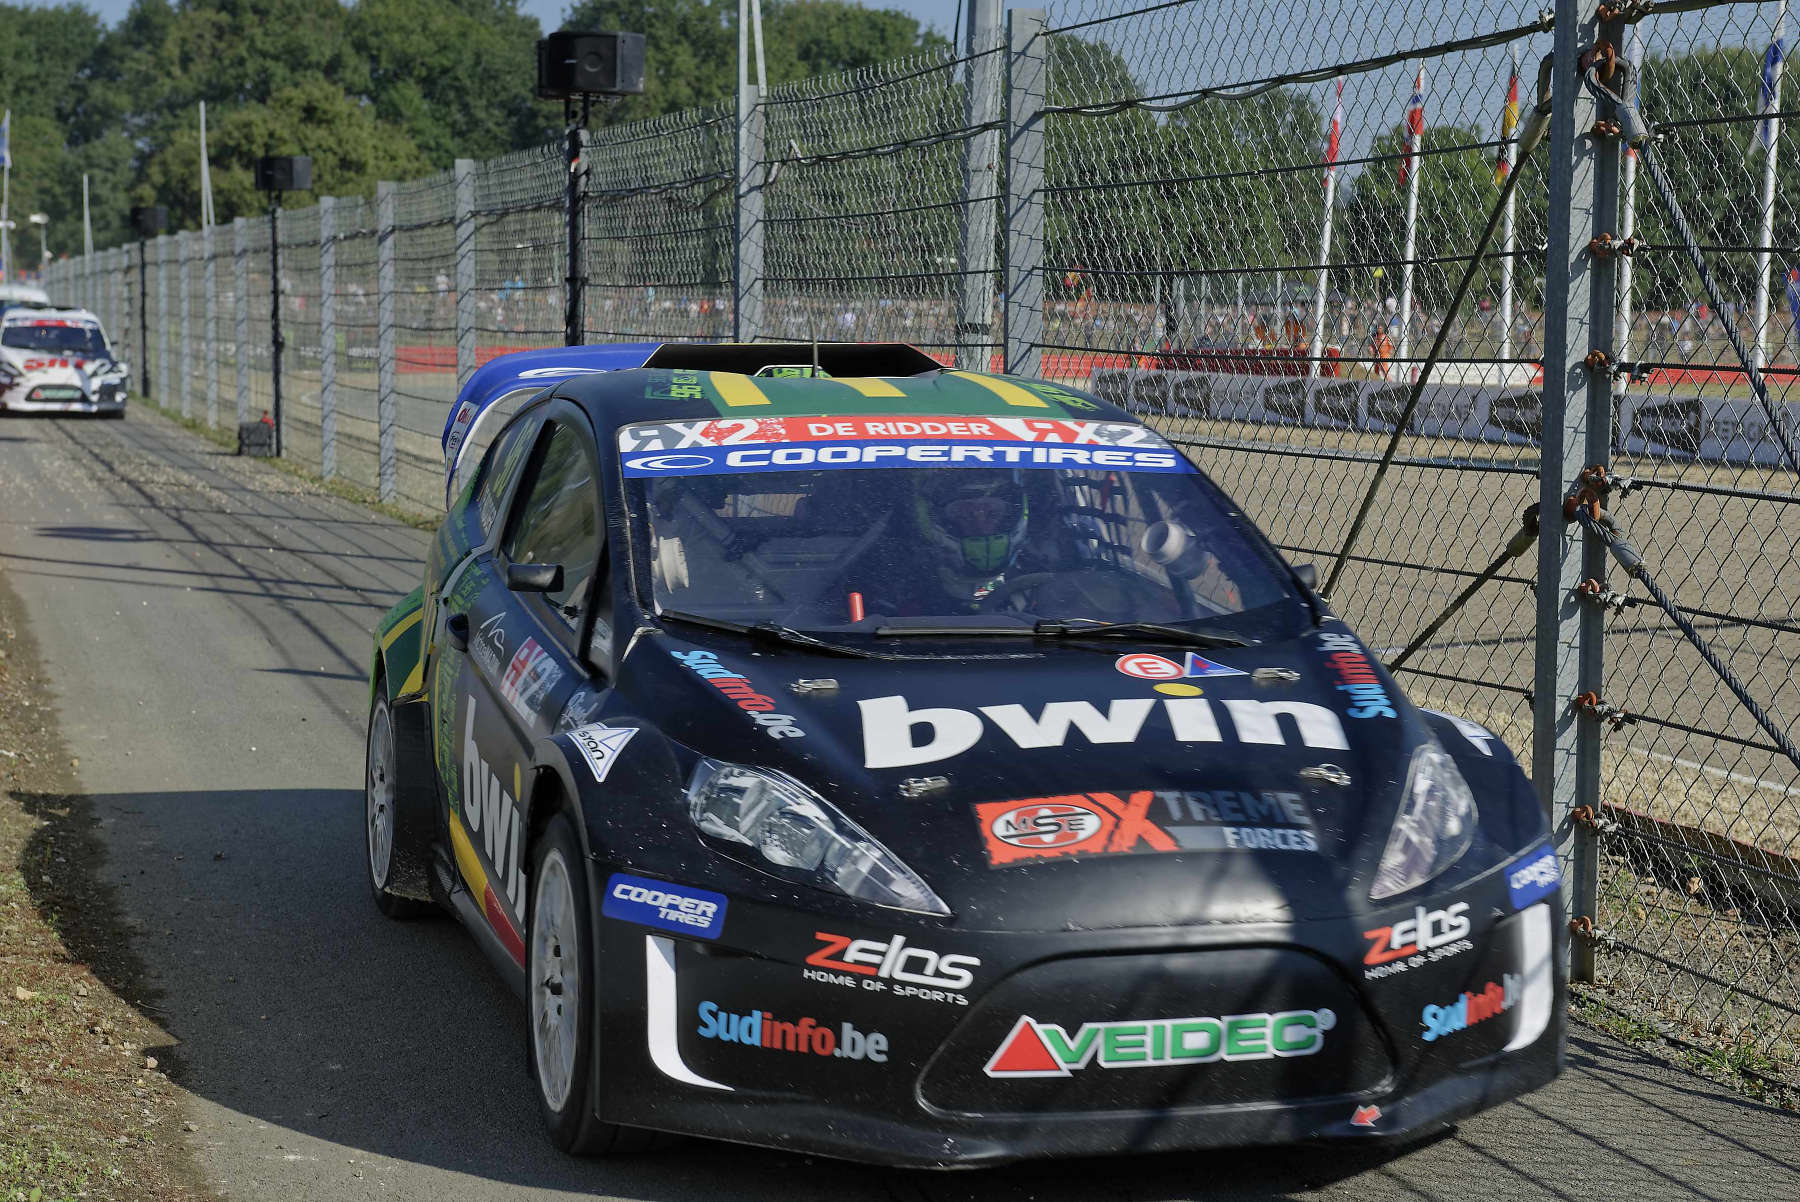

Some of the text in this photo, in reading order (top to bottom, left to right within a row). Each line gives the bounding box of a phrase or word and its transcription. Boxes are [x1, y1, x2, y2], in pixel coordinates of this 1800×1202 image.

[808, 420, 991, 438] DE RIDDER
[725, 443, 1177, 469] COOPERTIRES
[670, 649, 806, 741] Sudinfo.be
[857, 680, 1351, 769] bwin
[463, 694, 527, 925] bwi
[1003, 810, 1092, 842] MSE
[1224, 826, 1319, 851] FORCES
[612, 882, 719, 916] COOPER
[658, 908, 714, 929] TIRES
[803, 968, 970, 1007] HOME OF SPORTS
[696, 1000, 889, 1063] Sudinfo.be
